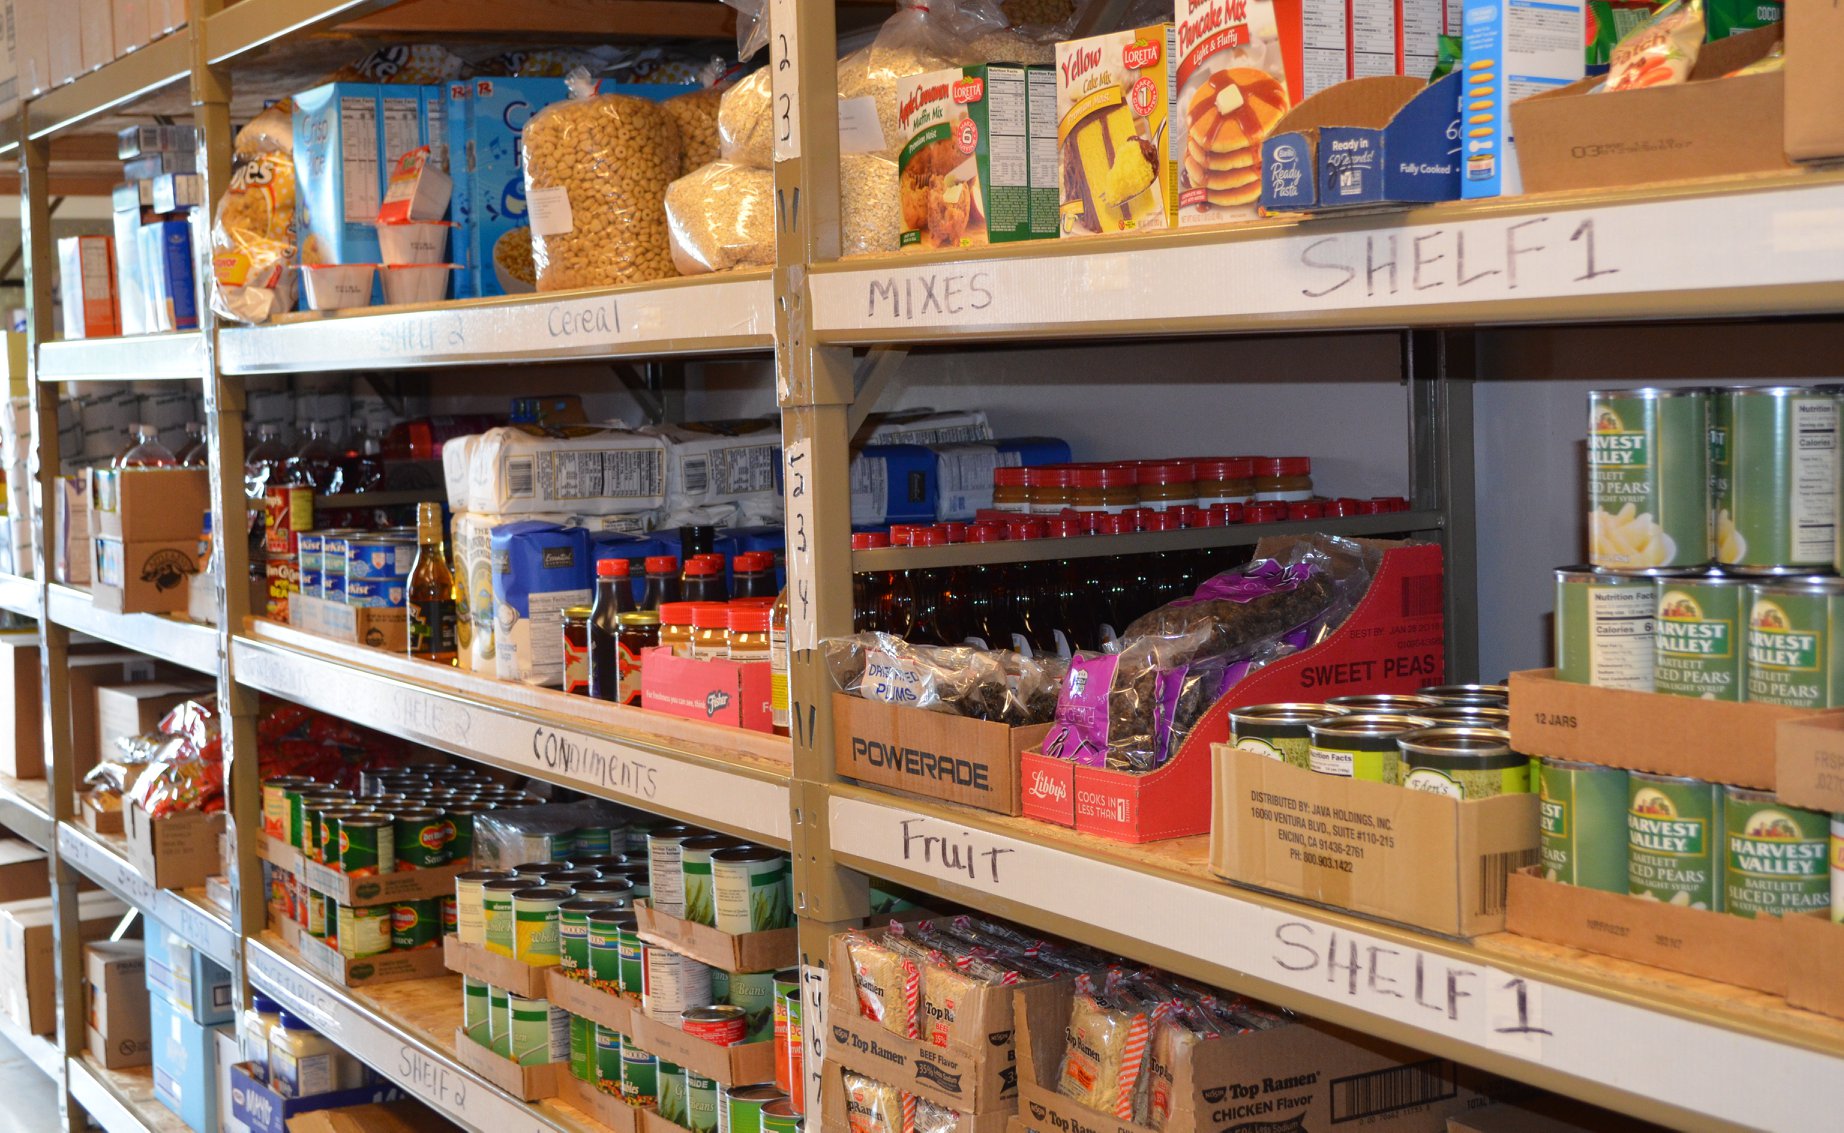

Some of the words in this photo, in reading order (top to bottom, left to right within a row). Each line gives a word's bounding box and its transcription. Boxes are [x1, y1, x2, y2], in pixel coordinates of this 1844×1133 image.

[1178, 1, 1222, 57] Pancake
[1225, 0, 1246, 24] Mix
[779, 34, 790, 71] 2
[1124, 46, 1157, 64] LORETTA
[1193, 46, 1209, 66] Light
[1217, 29, 1238, 48] Fluffy
[1061, 47, 1102, 88] Yellow
[954, 83, 982, 99] LORETTA
[1083, 72, 1098, 93] Cake
[1099, 70, 1111, 86] Mix
[1140, 86, 1148, 107] 1
[779, 93, 790, 142] 3
[931, 106, 943, 121] Mix
[961, 127, 973, 144] 6
[1332, 139, 1359, 152] Ready
[1359, 138, 1369, 148] in
[1270, 163, 1302, 185] Ready
[1400, 164, 1419, 176] Fully
[1419, 163, 1451, 175] Cooked
[1273, 179, 1299, 199] Pasta
[1300, 217, 1550, 299] SHELF
[1571, 217, 1621, 283] 1
[868, 272, 993, 320] MIXES
[547, 299, 621, 339] Cereal
[1799, 438, 1831, 447] Calories
[1606, 482, 1650, 494] PEARS
[1594, 593, 1634, 601] Nutrition
[1635, 592, 1656, 600] Fact
[1596, 625, 1634, 634] Calories
[1300, 660, 1377, 689] SWEET
[1383, 654, 1437, 679] PEAS
[1683, 670, 1731, 684] PEARS
[670, 696, 679, 705] you
[708, 690, 730, 714] Fisher
[1770, 683, 1819, 699] PEARS
[1535, 713, 1547, 725] 12
[1548, 714, 1578, 729] JARS
[852, 736, 988, 791] POWERADE
[1331, 753, 1352, 763] Facts
[1028, 770, 1068, 803] Libby's
[1411, 778, 1448, 794] Eden's
[1077, 791, 1106, 807] COOKS
[1107, 796, 1117, 809] IN
[1250, 790, 1297, 811] DISTRIBUTED
[1298, 800, 1310, 814] BY:
[1311, 804, 1332, 819] JAVA
[1332, 808, 1376, 829] HOLDINGS,
[1376, 816, 1393, 831] INC.
[1077, 803, 1095, 818] LESS
[1095, 807, 1117, 821] THAN
[1251, 807, 1273, 822] 16060
[1274, 812, 1307, 829] VENTURA
[1332, 824, 1355, 841] SUITE
[1357, 830, 1395, 849] #110-215
[1278, 828, 1307, 848] ENCINO,
[1307, 835, 1318, 848] CA
[1318, 839, 1365, 859] 91436-2761
[1730, 837, 1825, 859] HARVEST
[1290, 847, 1302, 862] PH:
[1303, 851, 1354, 874] 800.903.1422
[1738, 855, 1813, 875] VALLEY
[1657, 866, 1706, 883] PEARS
[1744, 877, 1805, 892] BARTLETT
[1728, 884, 1776, 905] SLICED
[1780, 891, 1830, 906] PEARS
[737, 982, 766, 997] Beans
[1272, 921, 1477, 1021] SHELF
[1493, 977, 1553, 1038] 1
[812, 991, 822, 1023] 4
[926, 1001, 943, 1021] Top
[851, 1033, 869, 1052] Top
[870, 1040, 906, 1066] Ramen
[919, 1048, 937, 1061] BEEF
[937, 1052, 959, 1070] Flavor
[1151, 1056, 1164, 1078] Top
[812, 1071, 822, 1105] 7
[1228, 1082, 1260, 1102] Top
[1261, 1071, 1318, 1095] Ramen
[1212, 1100, 1274, 1124] CHICKEN
[1276, 1092, 1314, 1111] Flavor
[1048, 1110, 1070, 1131] Top
